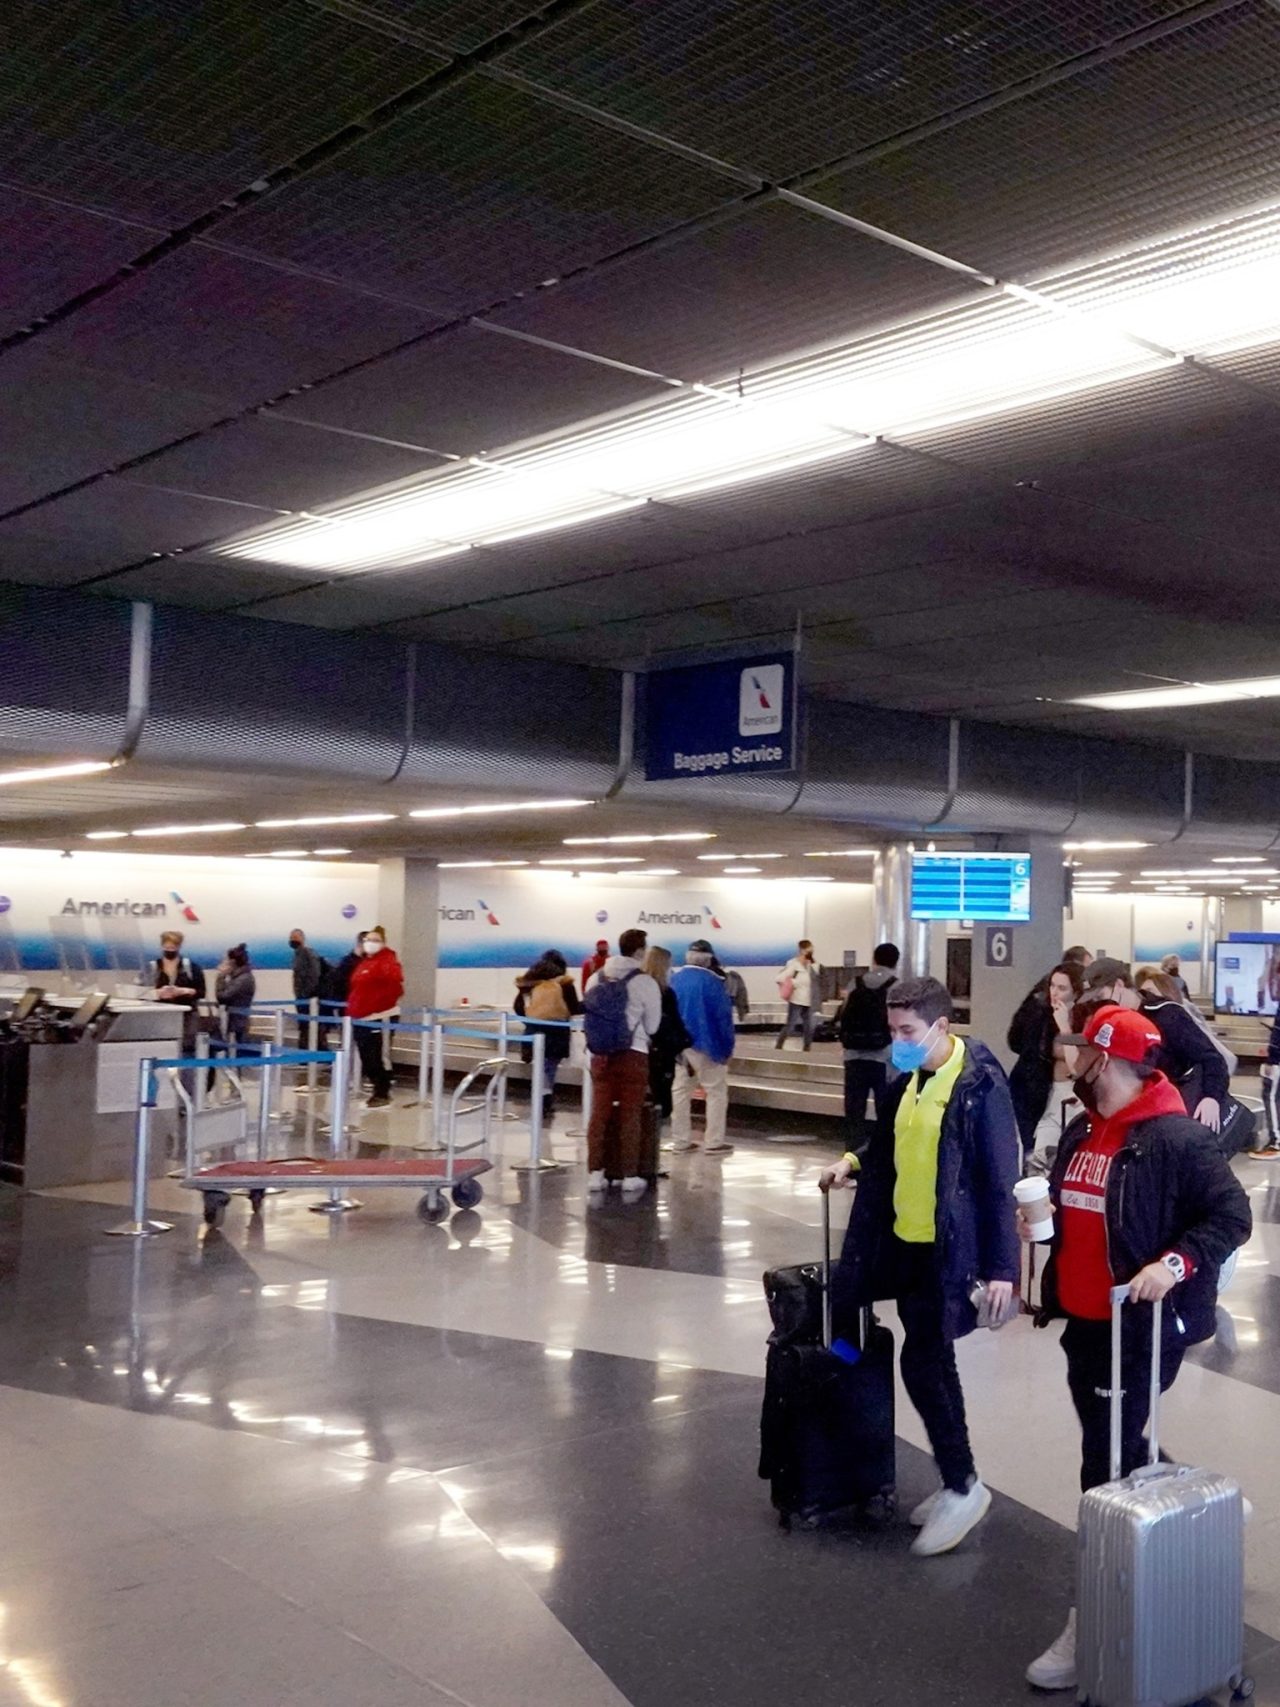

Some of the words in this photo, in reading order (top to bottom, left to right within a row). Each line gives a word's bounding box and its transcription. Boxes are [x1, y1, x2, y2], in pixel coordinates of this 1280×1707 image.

[674, 752, 729, 771] Baggage
[731, 744, 782, 764] Service
[1015, 862, 1026, 875] 6
[62, 897, 166, 916] American
[637, 910, 702, 924] American
[991, 932, 1007, 962] 6
